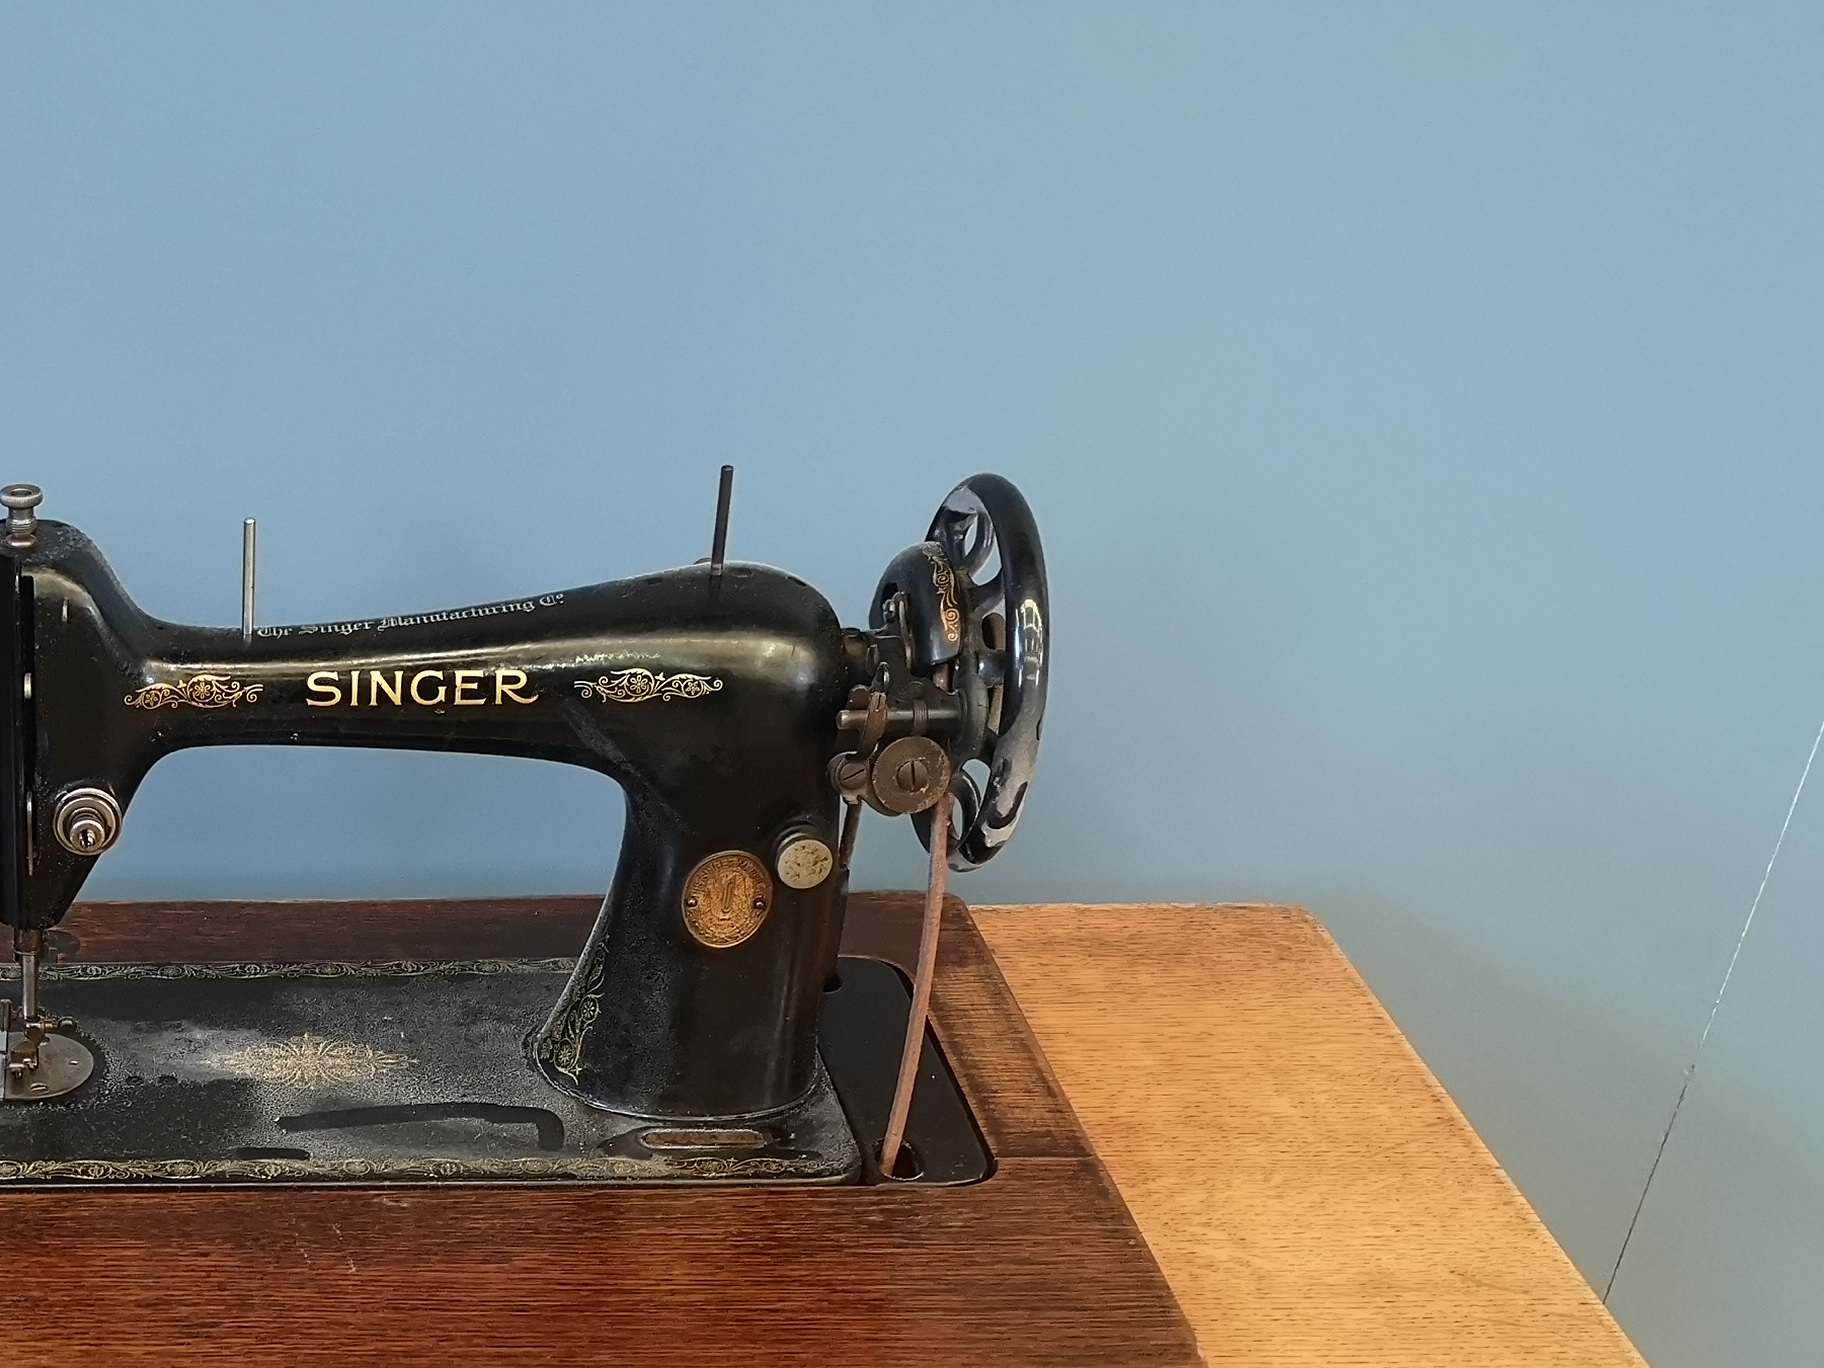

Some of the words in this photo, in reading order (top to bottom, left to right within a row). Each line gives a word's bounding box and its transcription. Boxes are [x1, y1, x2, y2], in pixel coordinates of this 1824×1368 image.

[256, 626, 293, 639] The
[298, 621, 375, 636] Singer
[376, 599, 536, 632] Manufacturing
[305, 668, 539, 707] SINGER
